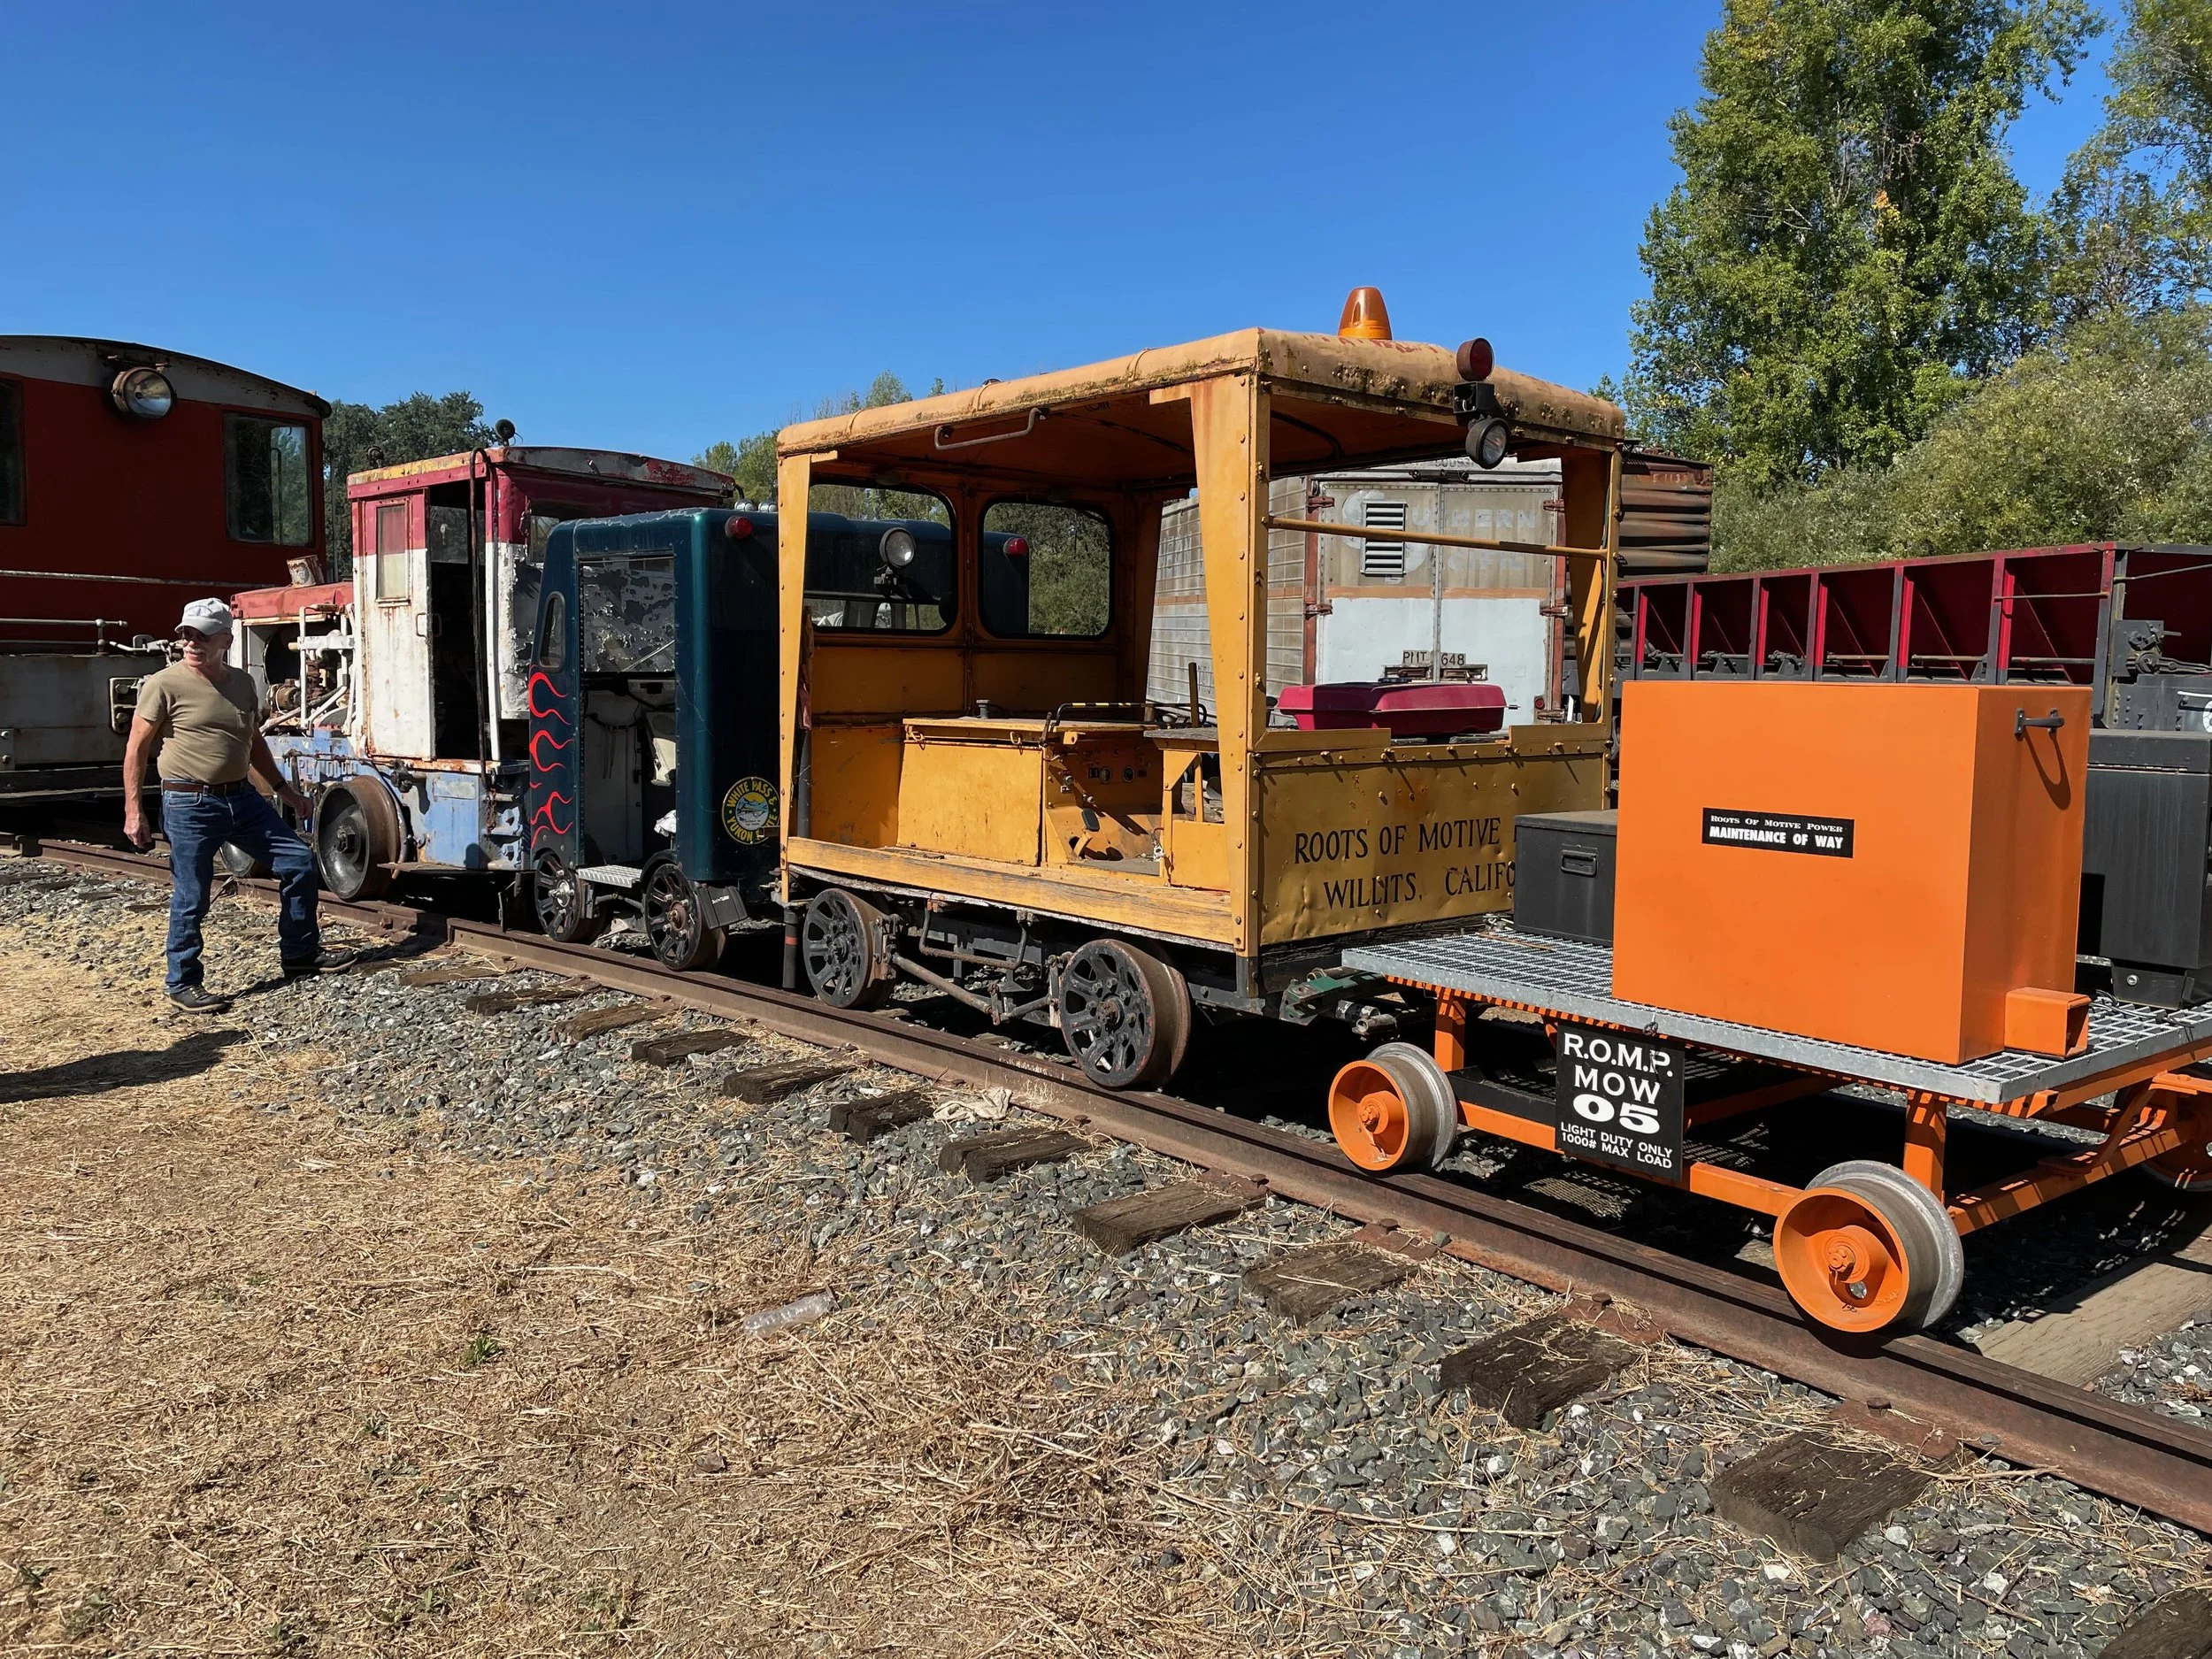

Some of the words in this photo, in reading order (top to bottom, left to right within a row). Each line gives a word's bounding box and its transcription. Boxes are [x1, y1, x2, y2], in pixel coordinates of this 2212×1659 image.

[1440, 653, 1465, 666] 648
[726, 781, 749, 807] WHITE
[752, 780, 772, 797] PASS
[768, 796, 778, 805] &
[727, 816, 753, 841] YUKON
[1294, 828, 1369, 864] ROOTS
[1379, 825, 1407, 855] OF
[1418, 818, 1502, 852] MOTIVE
[1709, 826, 1786, 843] MAINTENANCE
[1793, 833, 1809, 846] OF
[1815, 834, 1844, 849] WAY
[1710, 815, 1740, 825] ROOTS
[1764, 819, 1801, 829] MOTIVE
[1807, 823, 1843, 833] POWER
[1563, 1033, 1673, 1078] R.O.M.P.
[1574, 1064, 1661, 1104] MOW
[1572, 1094, 1660, 1134] 05
[1561, 1122, 1596, 1139] LIGHT
[1601, 1132, 1633, 1148] DUTY
[1639, 1141, 1673, 1159] ONLY
[1562, 1132, 1597, 1149] 1000#
[1601, 1142, 1629, 1158] MAX
[1637, 1151, 1672, 1169] LOAD
